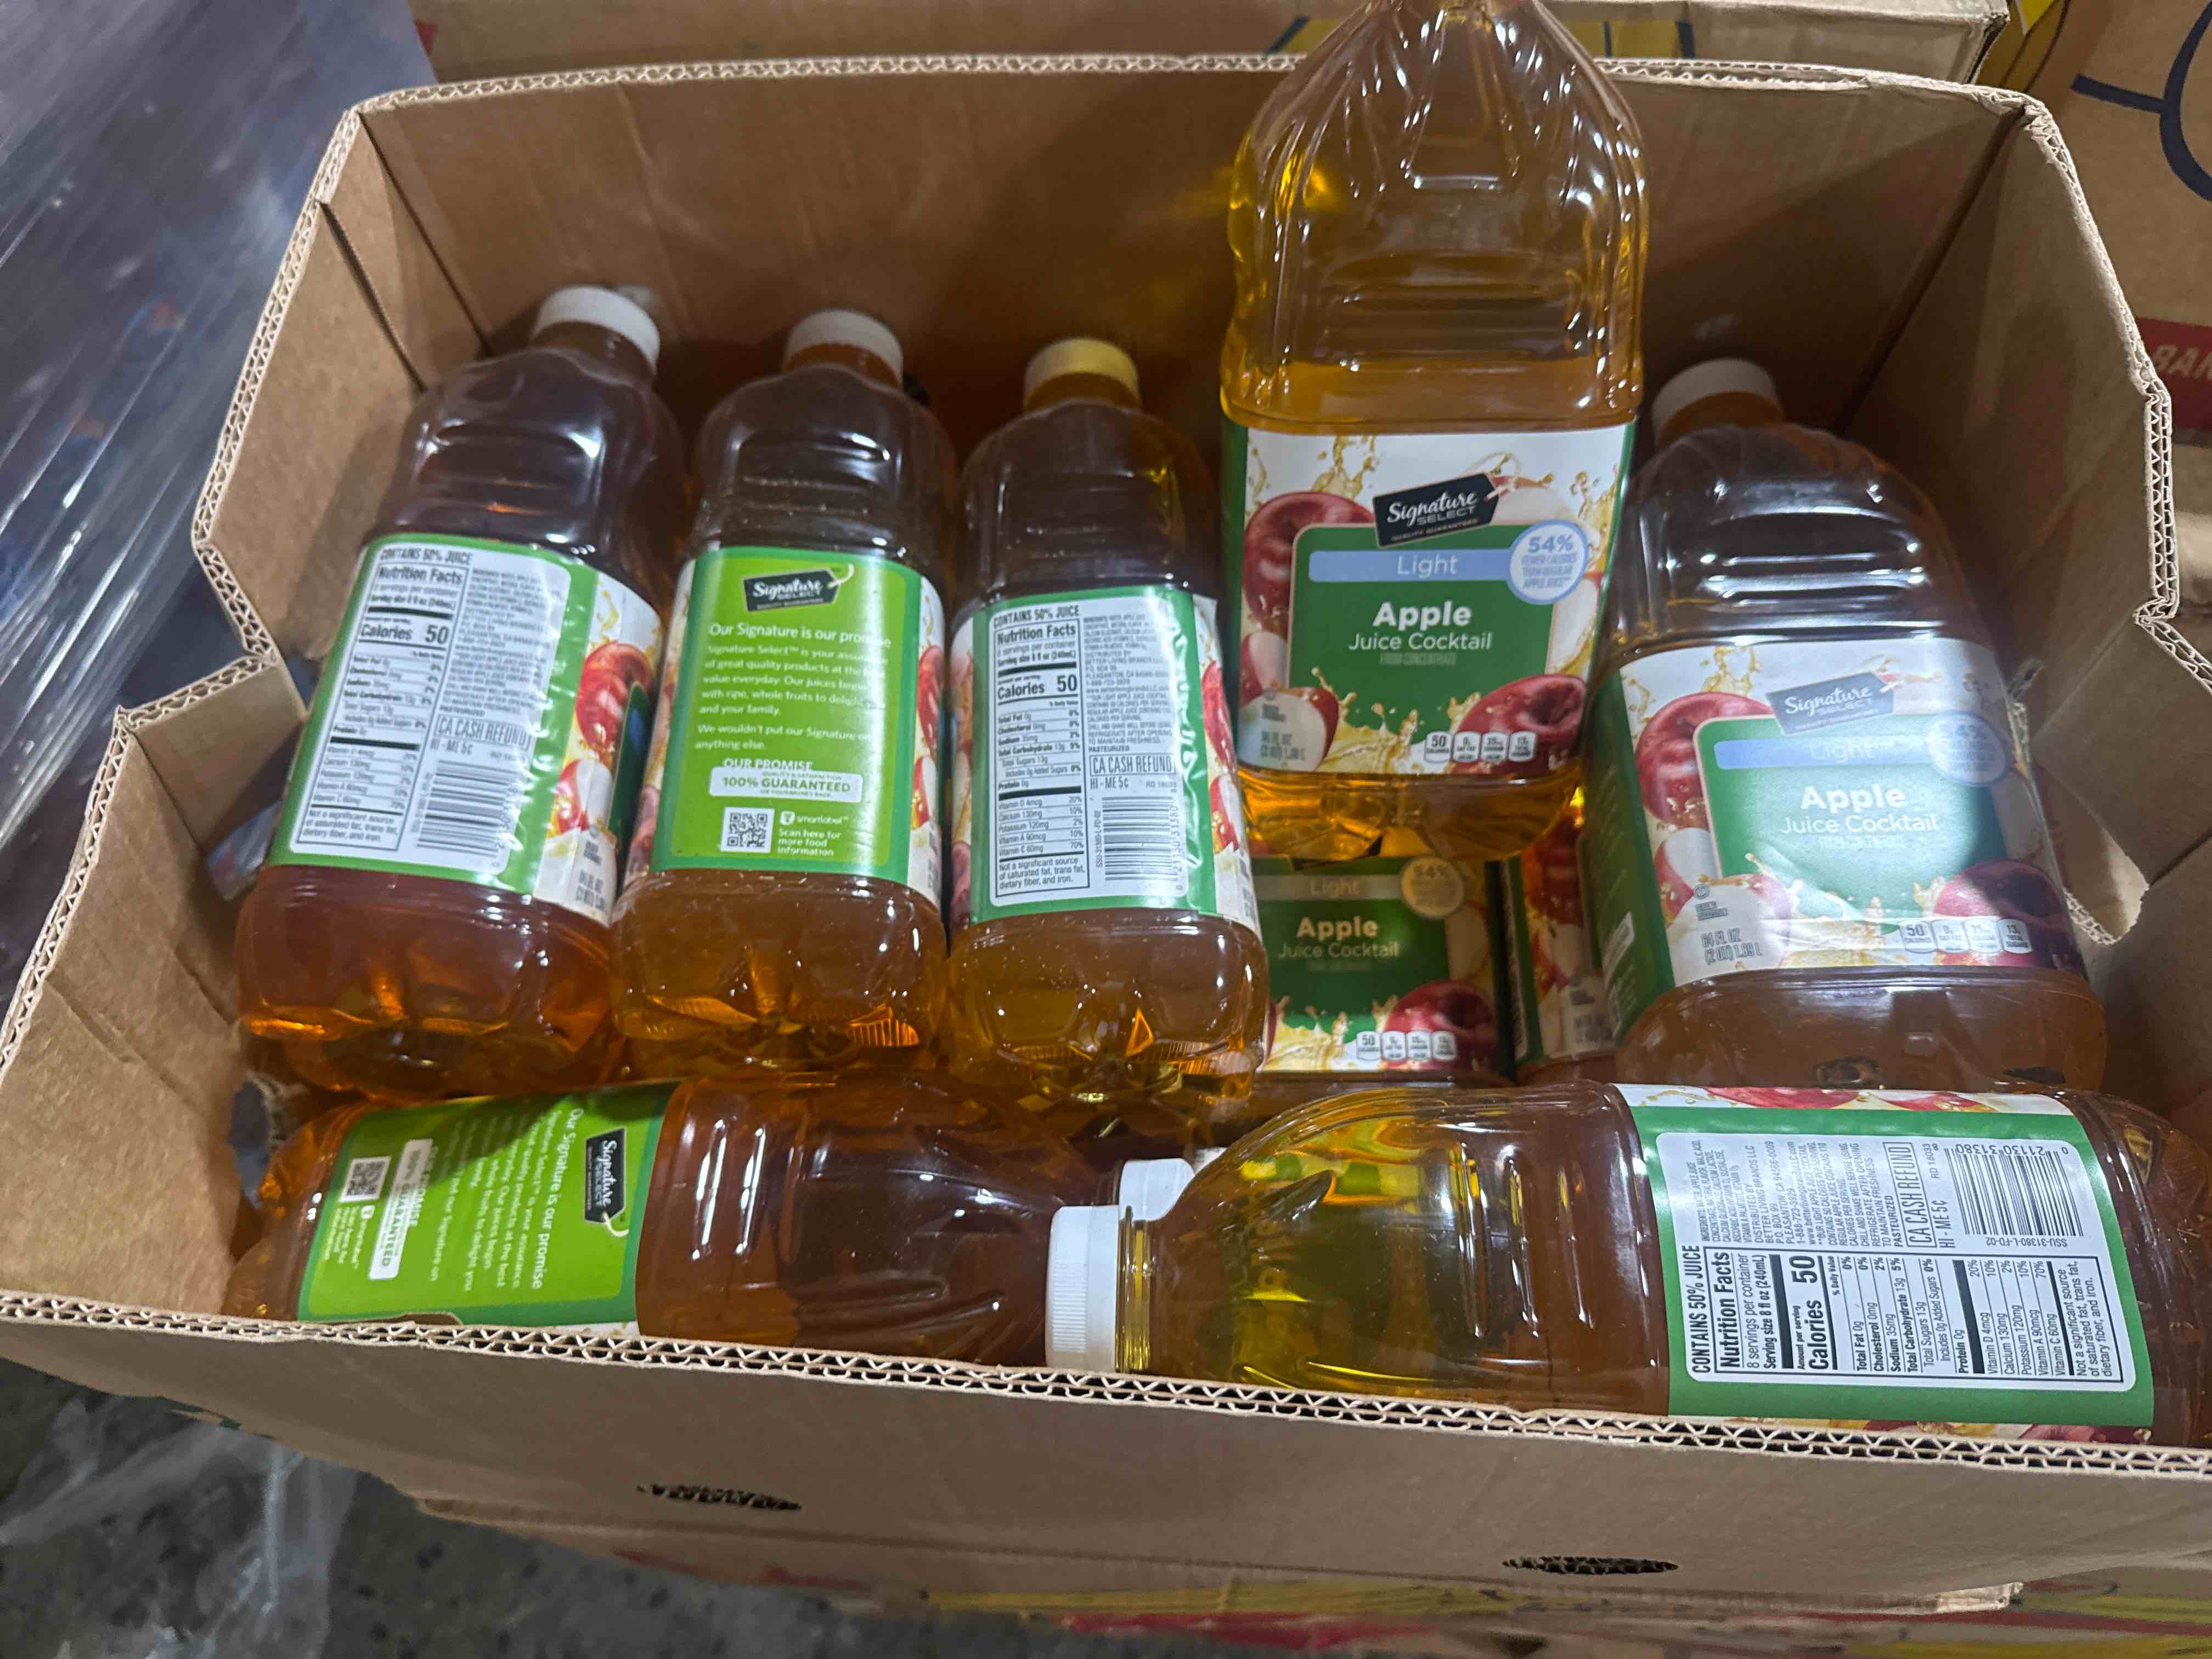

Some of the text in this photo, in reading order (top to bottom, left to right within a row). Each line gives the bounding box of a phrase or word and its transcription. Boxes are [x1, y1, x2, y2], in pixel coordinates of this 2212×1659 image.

[1387, 490, 1479, 527] Signature
[1417, 506, 1476, 525] SELECT
[1527, 534, 1573, 553] 54%
[380, 566, 463, 584] Nutrition Facts
[1397, 555, 1458, 579] Light
[753, 578, 822, 601] Signature
[994, 605, 1080, 628] CONTAINS 50% JUICE
[1372, 600, 1472, 631] Apple
[360, 624, 450, 644] Calories 50
[710, 622, 837, 641] Our Signature is our
[997, 624, 1076, 645] Nutrition Facts
[1348, 631, 1493, 651] Juice Cocktail
[997, 674, 1077, 700] Calories 50
[1785, 686, 1874, 717] Signature
[1432, 736, 1447, 747] 50
[723, 758, 813, 771] OUR PROMISE
[1093, 755, 1172, 774] CA CASH REFUND
[723, 776, 850, 792] 100% GUARANTEED
[1800, 783, 1906, 814] Apple
[779, 827, 842, 839] Scan here for
[1781, 814, 1940, 834] Juice Cocktail
[778, 838, 828, 848] more food
[778, 847, 834, 856] information
[1310, 878, 1362, 898] Light
[1296, 915, 1379, 941] Apple
[1906, 924, 1925, 936] 50
[1278, 940, 1400, 958] Juice Cocktail
[1746, 1145, 1756, 1158] LLC
[1955, 1144, 1997, 1154] 31380
[2003, 1145, 2043, 1155] 21130
[596, 1140, 617, 1207] Signature
[532, 1108, 584, 1290] Our Signature is our promise
[1759, 1189, 1769, 1213] LIVING
[1888, 1147, 1932, 1244] CA CASH REFUND
[1746, 1184, 1762, 1243] DISTRIBUTED BY
[1887, 1196, 1903, 1247] PASTEURIZED
[1933, 1215, 1951, 1229] ME
[1763, 1215, 1774, 1243] BETTER
[1938, 1238, 1955, 1248] HI
[1752, 1254, 1770, 1288] (240mL)
[1841, 1256, 1852, 1269] 0%
[1857, 1256, 1868, 1270] 0%
[1873, 1256, 1885, 1271] 2%
[1890, 1257, 1901, 1271] 5%
[1922, 1258, 1933, 1272] 0%
[1967, 1259, 1980, 1277] 20%
[1984, 1260, 1996, 1277] 10%
[2000, 1260, 2012, 1273] 2%
[2017, 1260, 2029, 1277] 10%
[2033, 1261, 2046, 1278] 70%
[1737, 1254, 1752, 1297] container
[2057, 1269, 2071, 1299] source
[1759, 1290, 1769, 1300] oz
[1681, 1245, 1710, 1373] CONTAINS 50% JUICE
[1712, 1252, 1739, 1367] Nutrition Facts
[1743, 1299, 1757, 1316] per
[1789, 1255, 1828, 1369] Calories 50
[1927, 1276, 1950, 1361] Includes 0g Added Sugars
[2067, 1261, 2100, 1376] of saturated fat, trans fat,
[1760, 1318, 1773, 1334] size
[1894, 1277, 1917, 1372] Total Carbohydrate 13g
[1915, 1301, 1934, 1367] Total Sugars 13g
[1980, 1312, 1991, 1334] 4mcg
[2029, 1309, 2042, 1336] 90mcg
[2046, 1313, 2058, 1336] 60mg
[2064, 1301, 2083, 1348] significant
[2085, 1277, 2112, 1376] dietary fiber, and iron.
[1745, 1318, 1759, 1359] servings
[1852, 1321, 1866, 1371] Total Fat 0g
[1866, 1302, 1883, 1371] Cholesterol 0mg
[1885, 1313, 1900, 1372] Sodium 35mg
[1996, 1312, 2015, 1374] Calcium 130mg
[2011, 1304, 2032, 1375] Potassium 120mg
[1763, 1337, 1776, 1369] Serving
[1953, 1329, 1968, 1373] Protein 0g
[1985, 1344, 1997, 1374] Vitamin
[2036, 1345, 2048, 1375] Vitamin
[2053, 1346, 2065, 1376] Vitamin
[2075, 1359, 2087, 1376] Not
